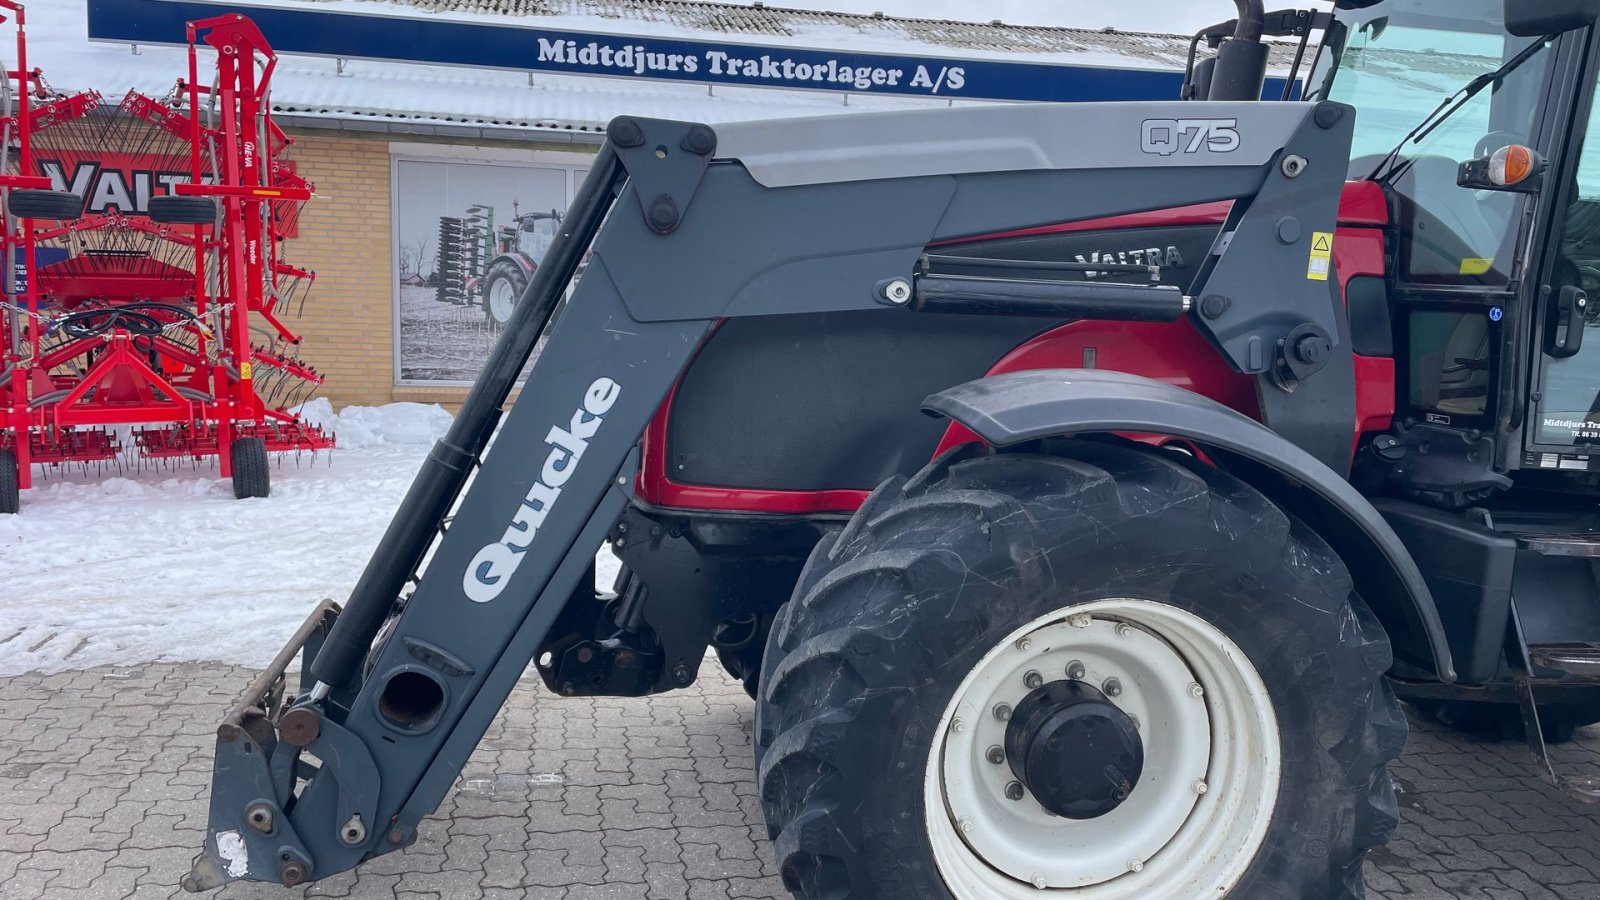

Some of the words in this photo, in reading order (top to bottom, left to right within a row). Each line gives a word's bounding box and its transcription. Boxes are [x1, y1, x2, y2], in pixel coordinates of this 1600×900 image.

[537, 38, 698, 75] Midtdjurs
[706, 50, 902, 89] Traktorlager
[910, 65, 966, 94] A/S
[1140, 117, 1241, 156] Q75
[249, 240, 257, 265] Weeder
[1543, 418, 1586, 429] Midtdjurs
[463, 376, 622, 603] Quicke
